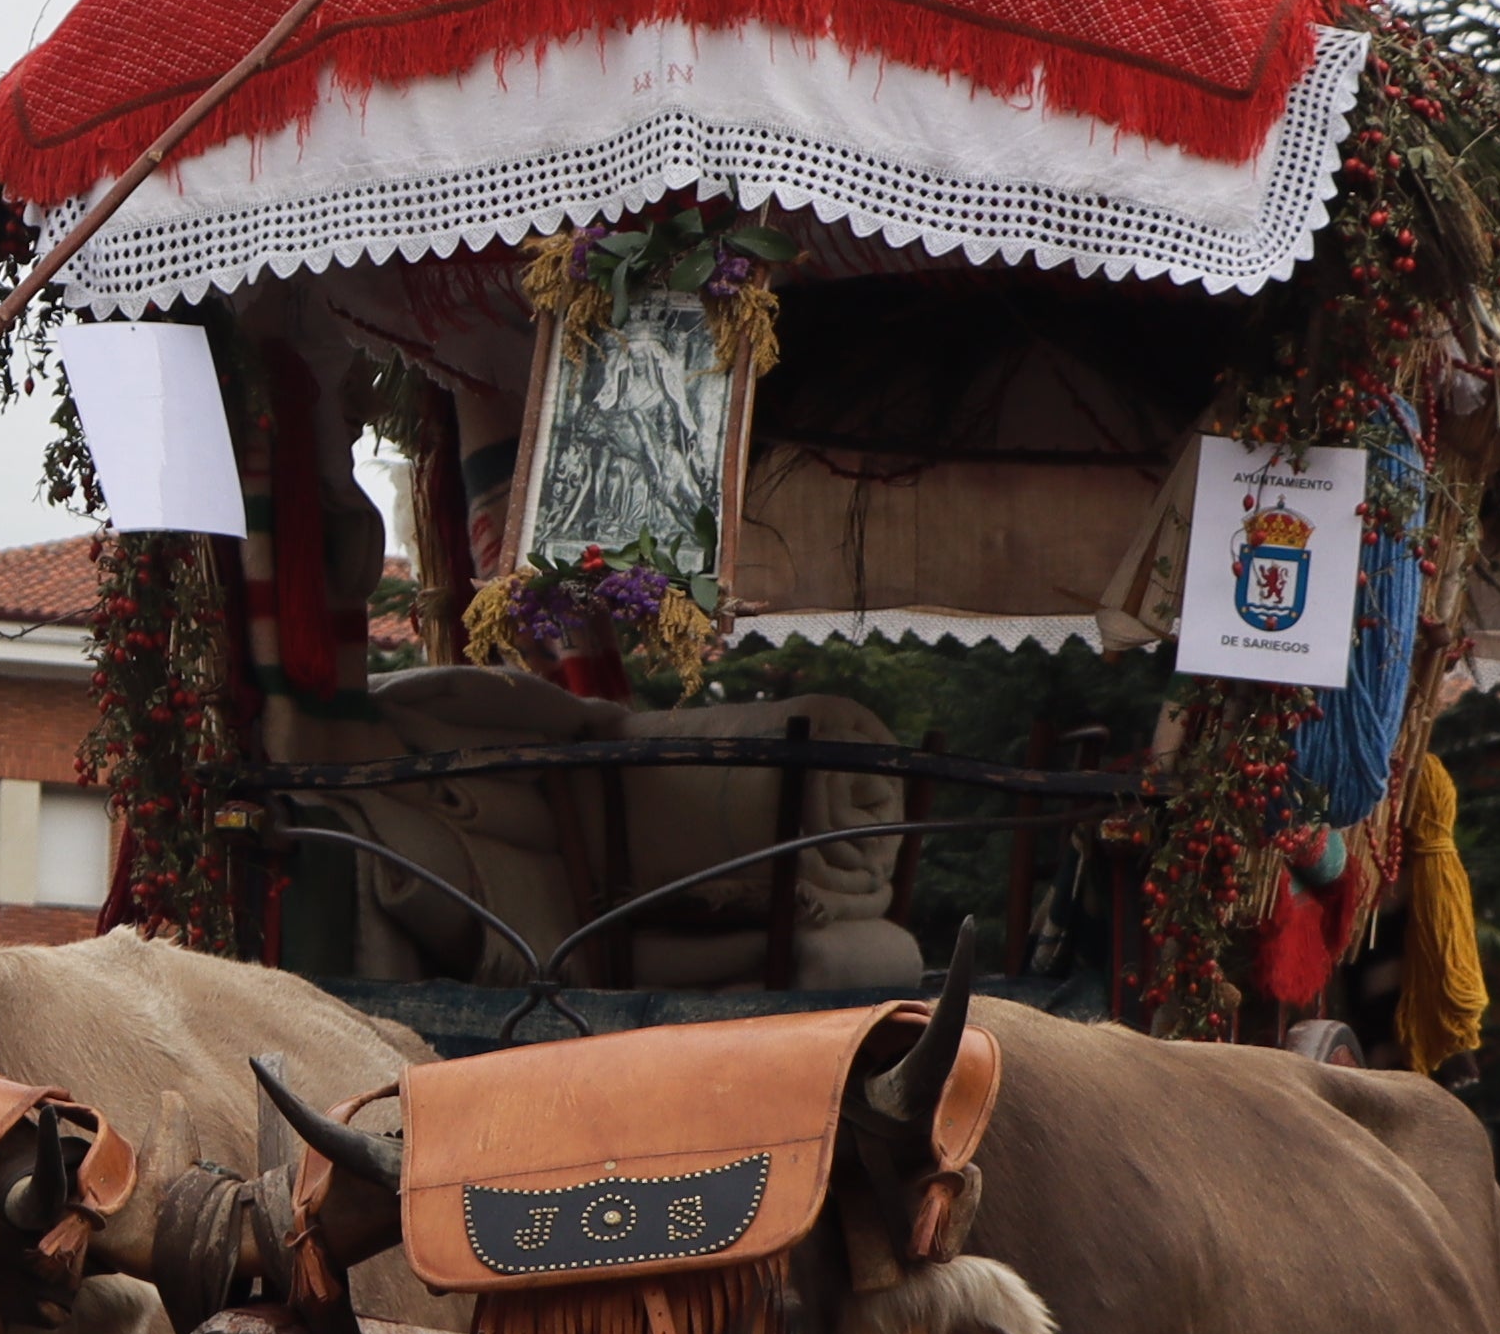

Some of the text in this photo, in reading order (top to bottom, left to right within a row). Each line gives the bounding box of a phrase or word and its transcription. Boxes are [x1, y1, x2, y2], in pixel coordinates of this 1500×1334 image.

[1233, 472, 1334, 491] AYUNTAMIENTO
[1220, 634, 1310, 654] DE SARIEGOS
